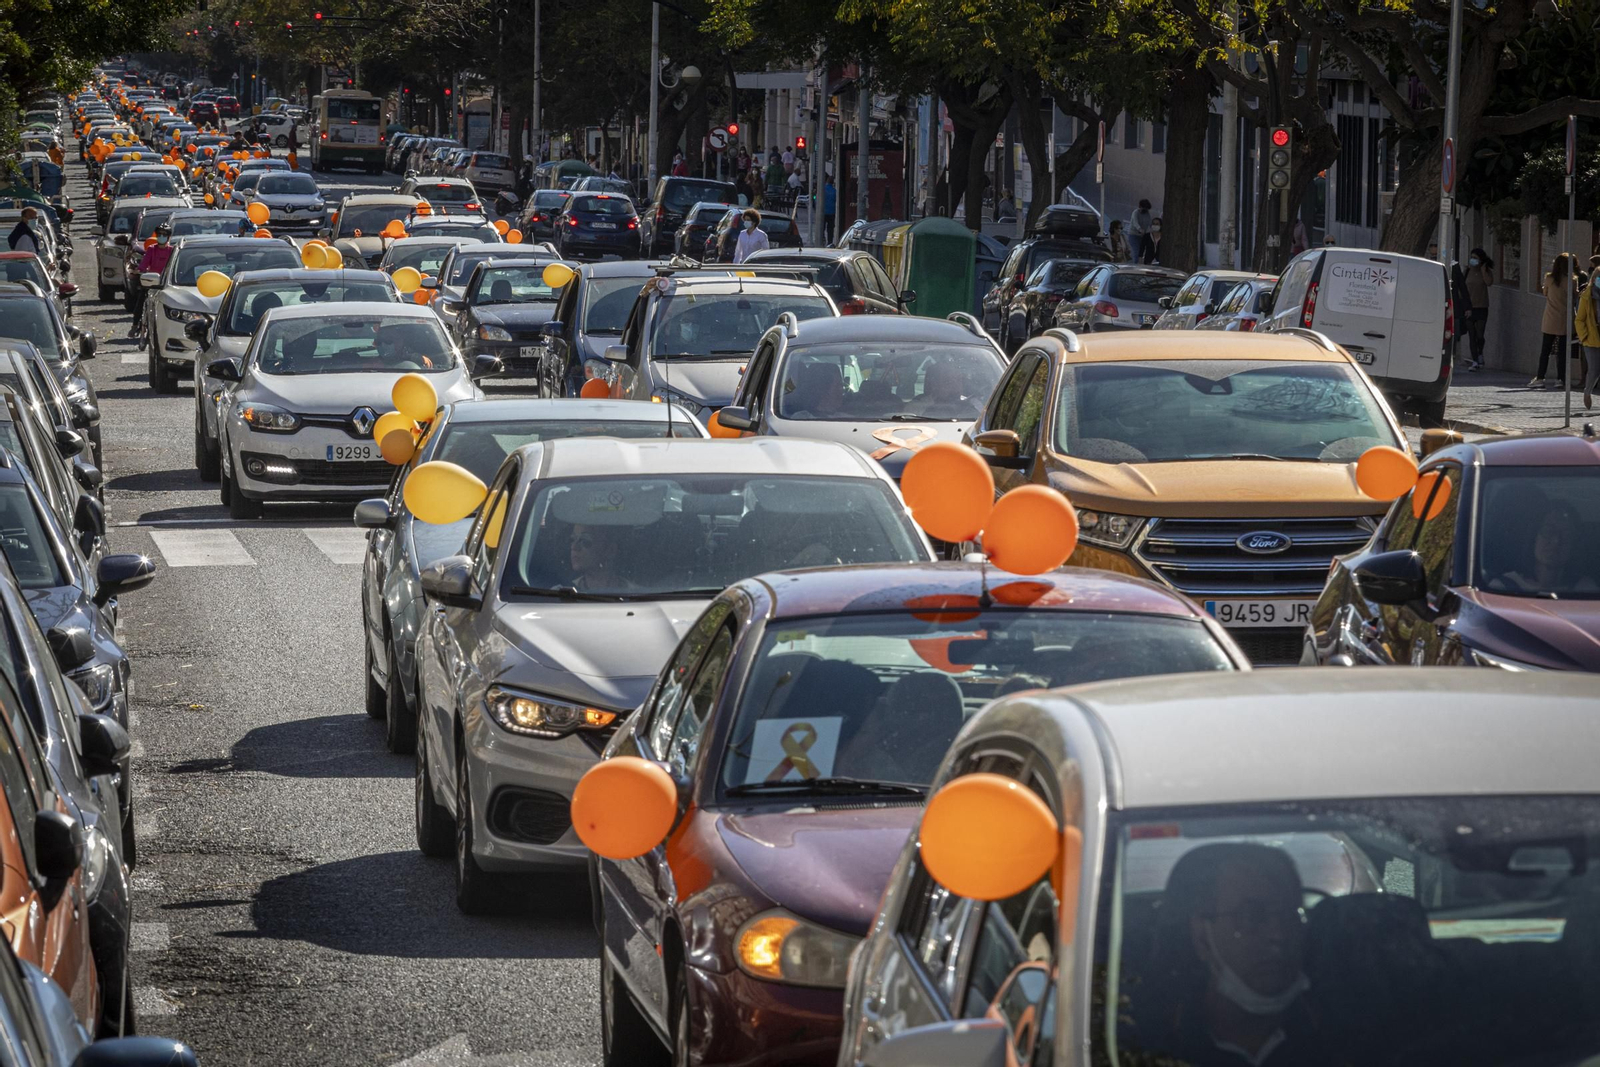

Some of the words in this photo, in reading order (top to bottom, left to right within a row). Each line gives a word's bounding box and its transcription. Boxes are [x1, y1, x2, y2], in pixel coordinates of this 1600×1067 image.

[1355, 353, 1371, 361] GJF
[336, 446, 371, 459] 9299
[1249, 535, 1279, 548] Ford
[1220, 603, 1275, 623] 9459
[1283, 603, 1315, 623] JR
